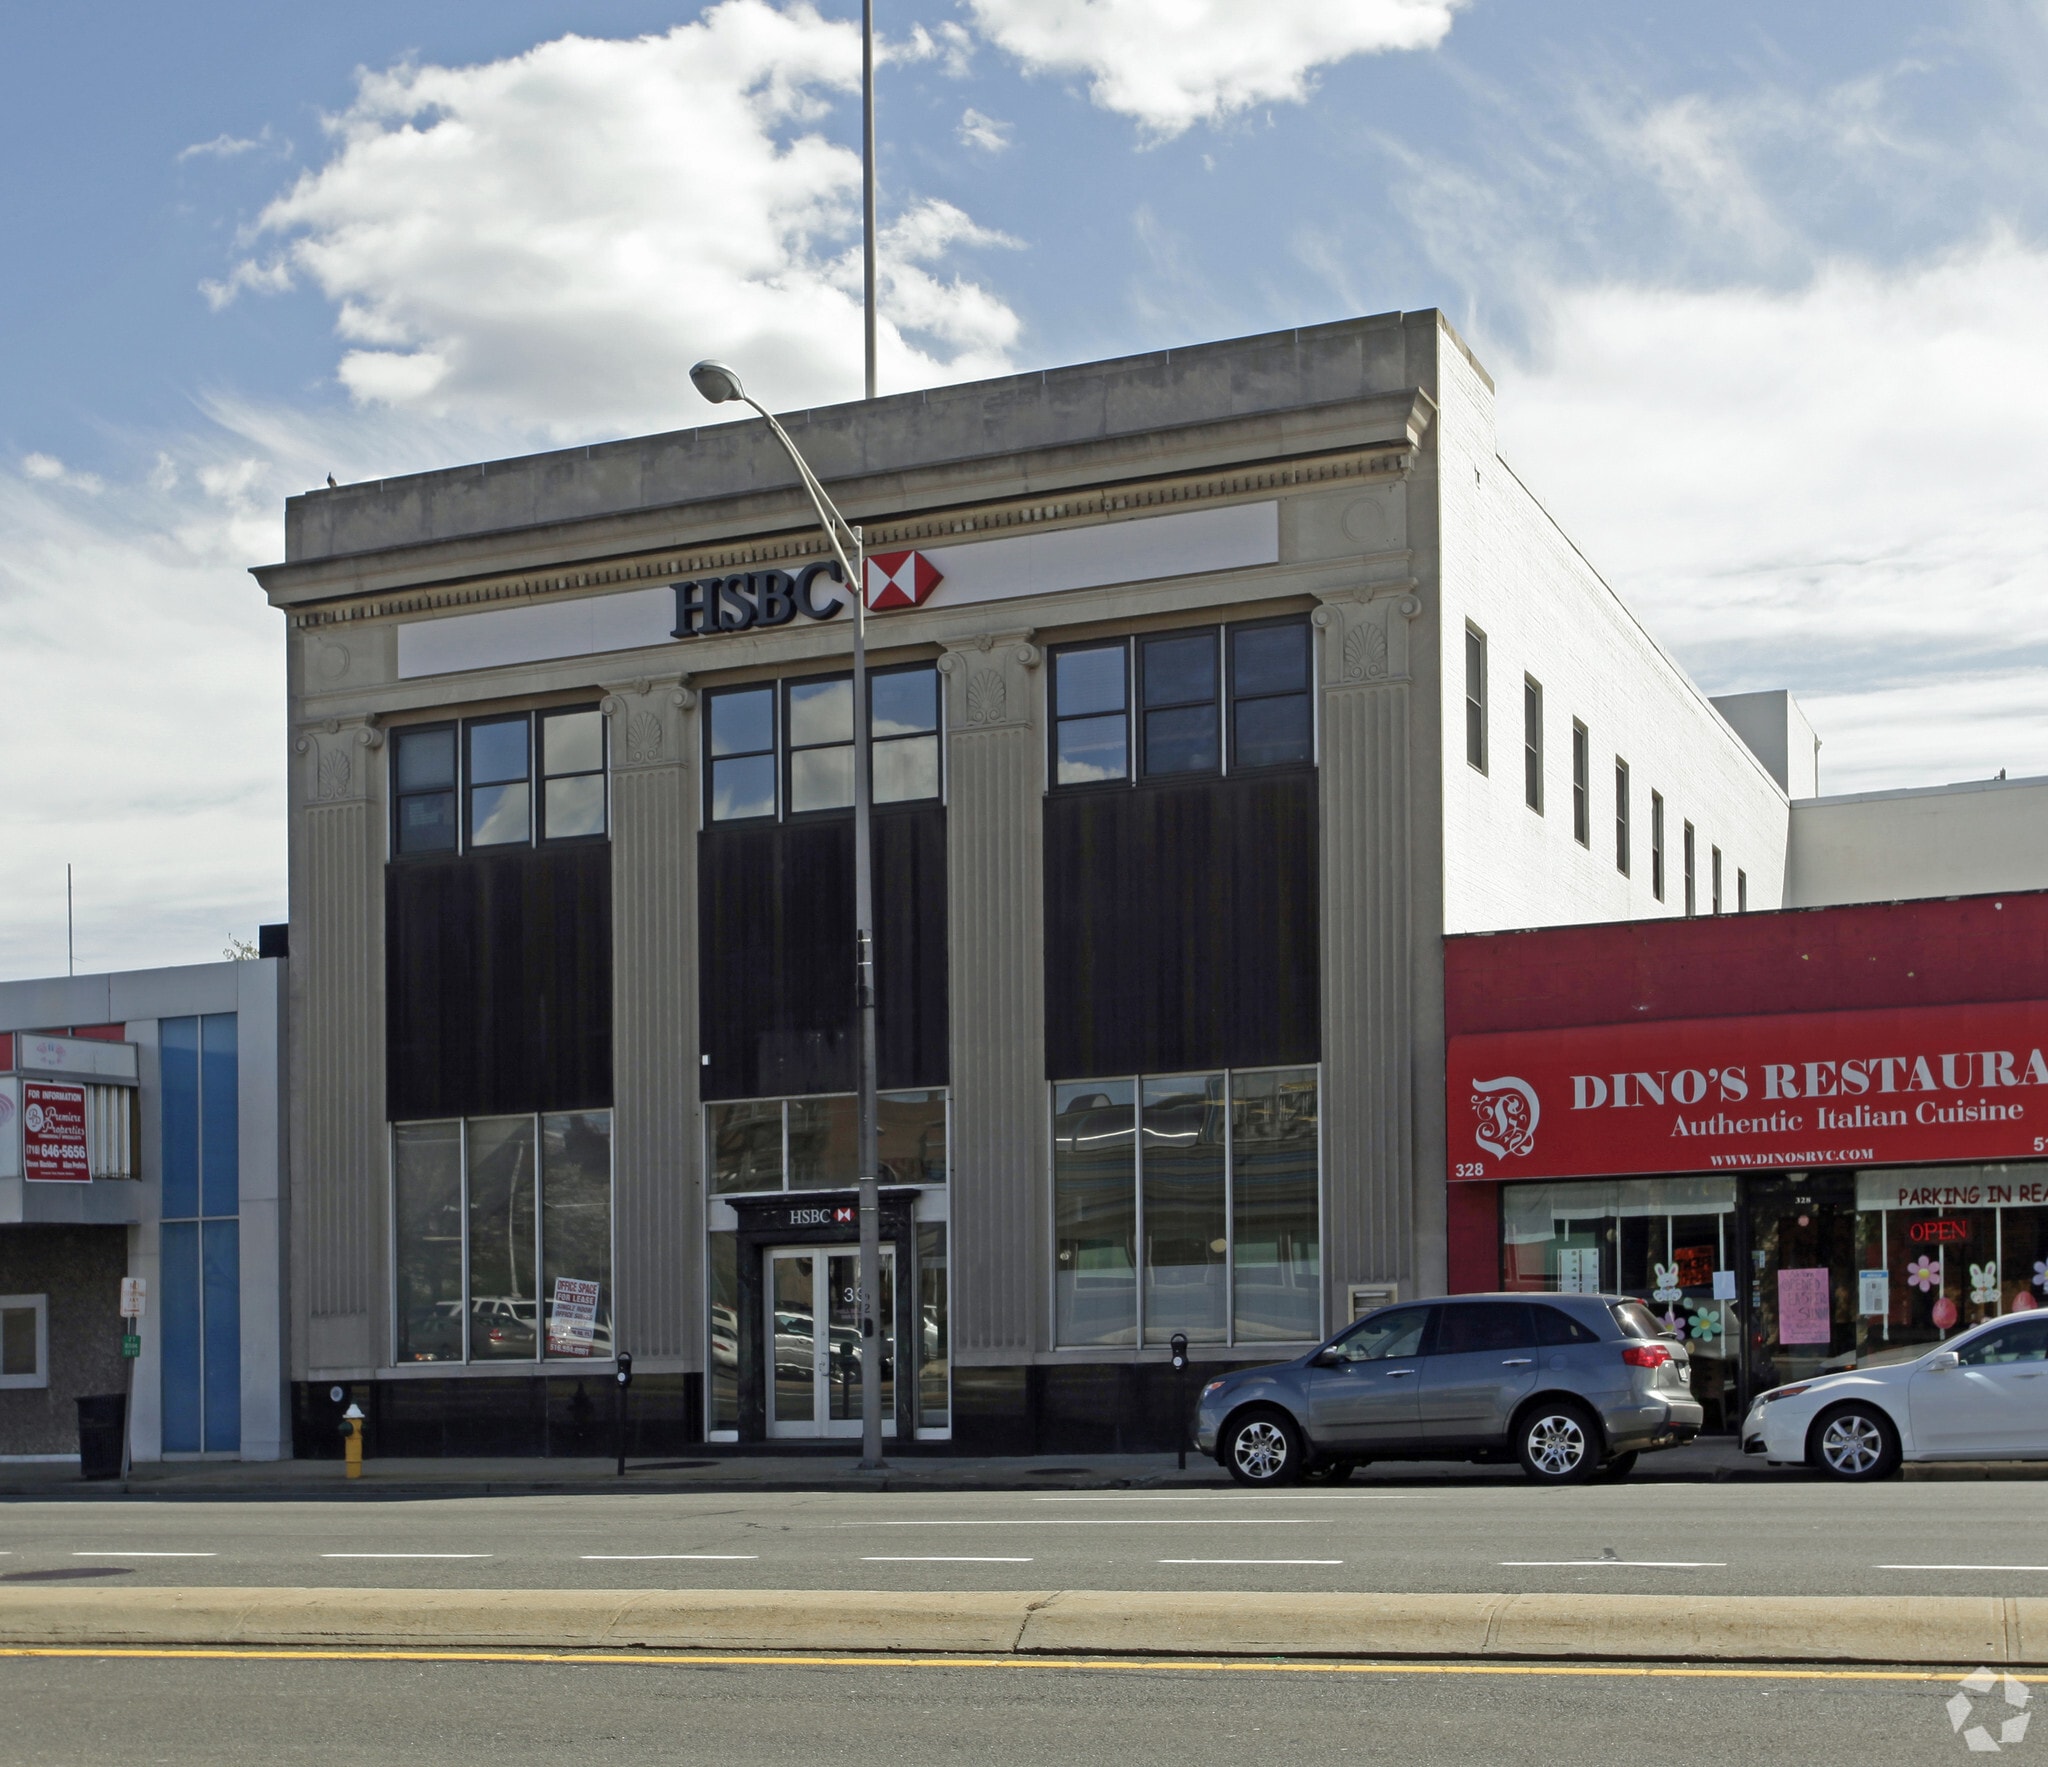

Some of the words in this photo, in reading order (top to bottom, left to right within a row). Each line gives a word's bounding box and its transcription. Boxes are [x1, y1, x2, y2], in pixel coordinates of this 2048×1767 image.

[670, 560, 844, 638] HSBC
[1569, 1066, 1749, 1110] DINO'S
[1761, 1048, 2048, 1100] RESTAURA
[28, 1089, 40, 1099] FOR
[42, 1090, 82, 1102] INFORMATION
[1670, 1109, 1803, 1137] Authentic
[1817, 1104, 1908, 1130] Italian
[1915, 1098, 2024, 1125] Cuisine
[1455, 1162, 1484, 1177] 328
[1899, 1186, 1980, 1206] PARKING
[1987, 1185, 2012, 1203] IN
[790, 1208, 831, 1224] HSBC
[1910, 1220, 1968, 1241] OPEN
[557, 1293, 571, 1302] FOR
[572, 1295, 595, 1305] LEASE
